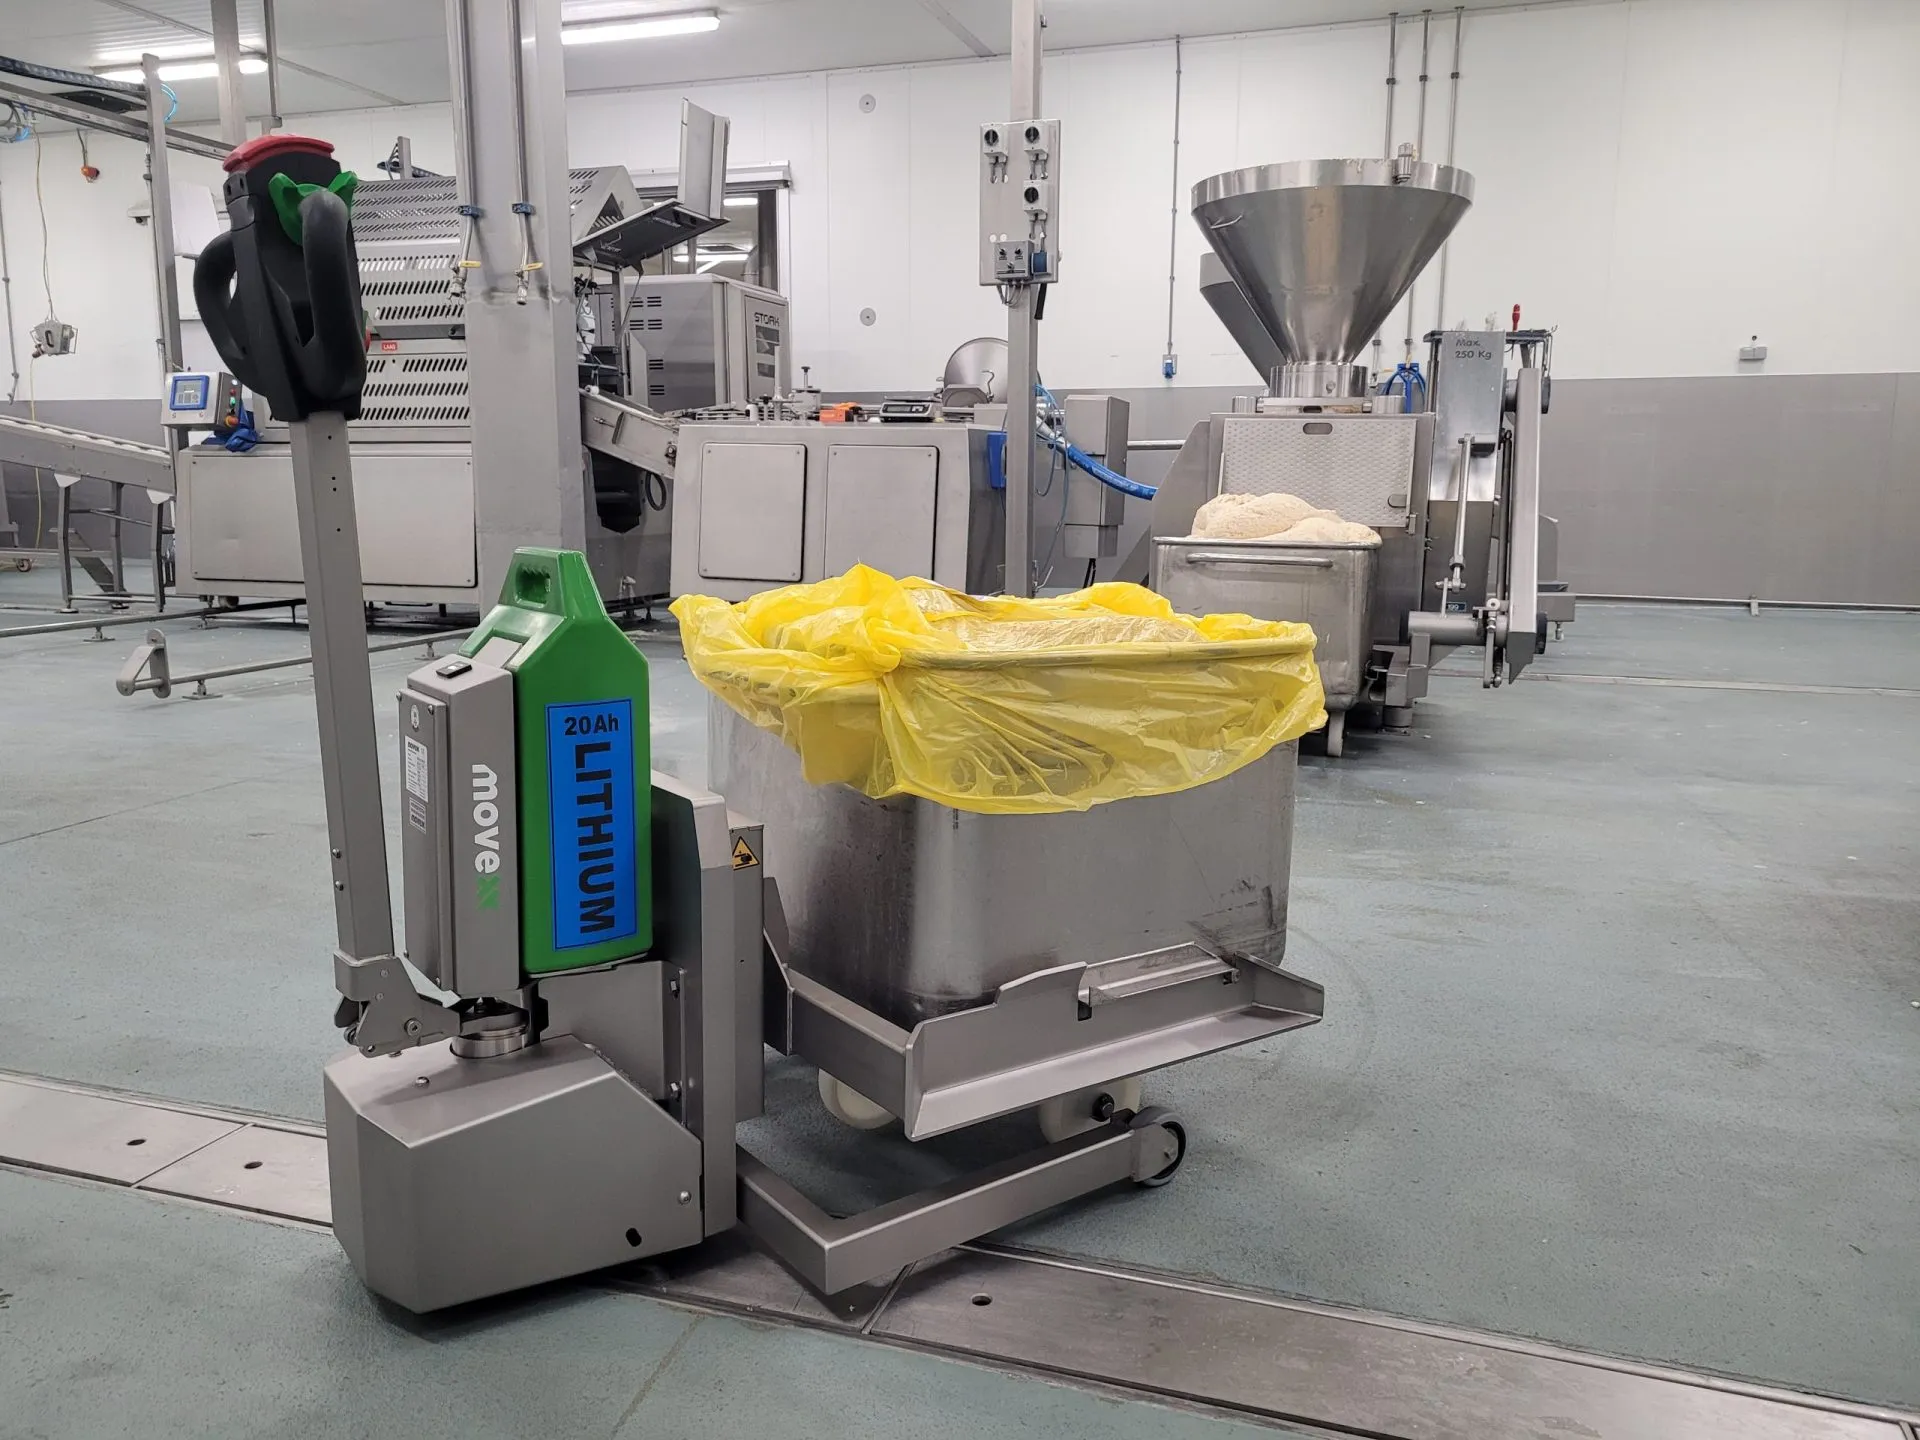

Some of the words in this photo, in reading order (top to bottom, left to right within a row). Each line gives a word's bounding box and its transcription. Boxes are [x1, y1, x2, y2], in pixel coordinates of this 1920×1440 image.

[754, 312, 780, 326] STORK
[1455, 350, 1475, 359] 250
[1478, 350, 1492, 361] Kg
[564, 713, 619, 736] 20Ah
[574, 741, 616, 934] LITHIUM
